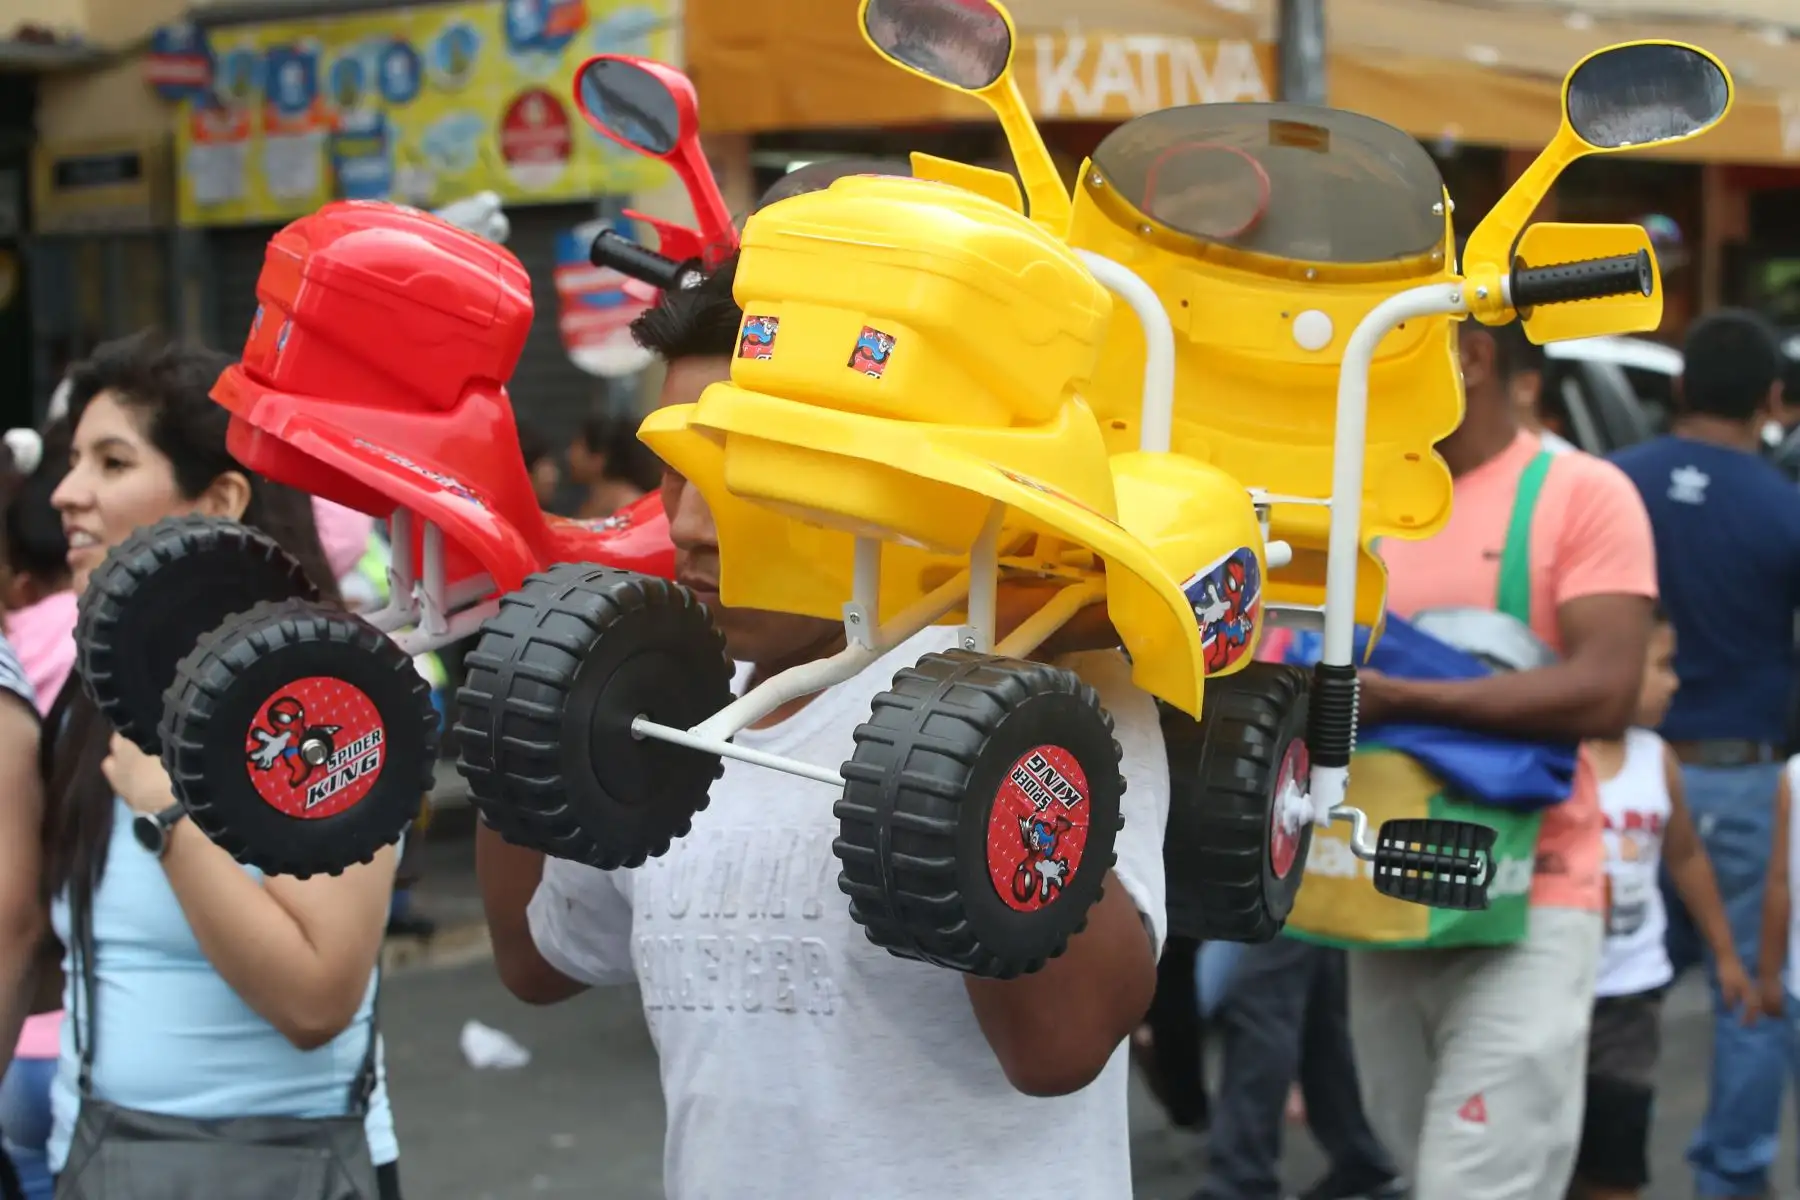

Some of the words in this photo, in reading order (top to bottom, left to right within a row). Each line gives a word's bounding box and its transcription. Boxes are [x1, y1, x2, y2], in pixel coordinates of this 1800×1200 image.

[327, 727, 383, 774] SPIDER
[305, 748, 380, 810] KING
[1011, 765, 1053, 812] SPIDER
[1024, 751, 1084, 810] KING
